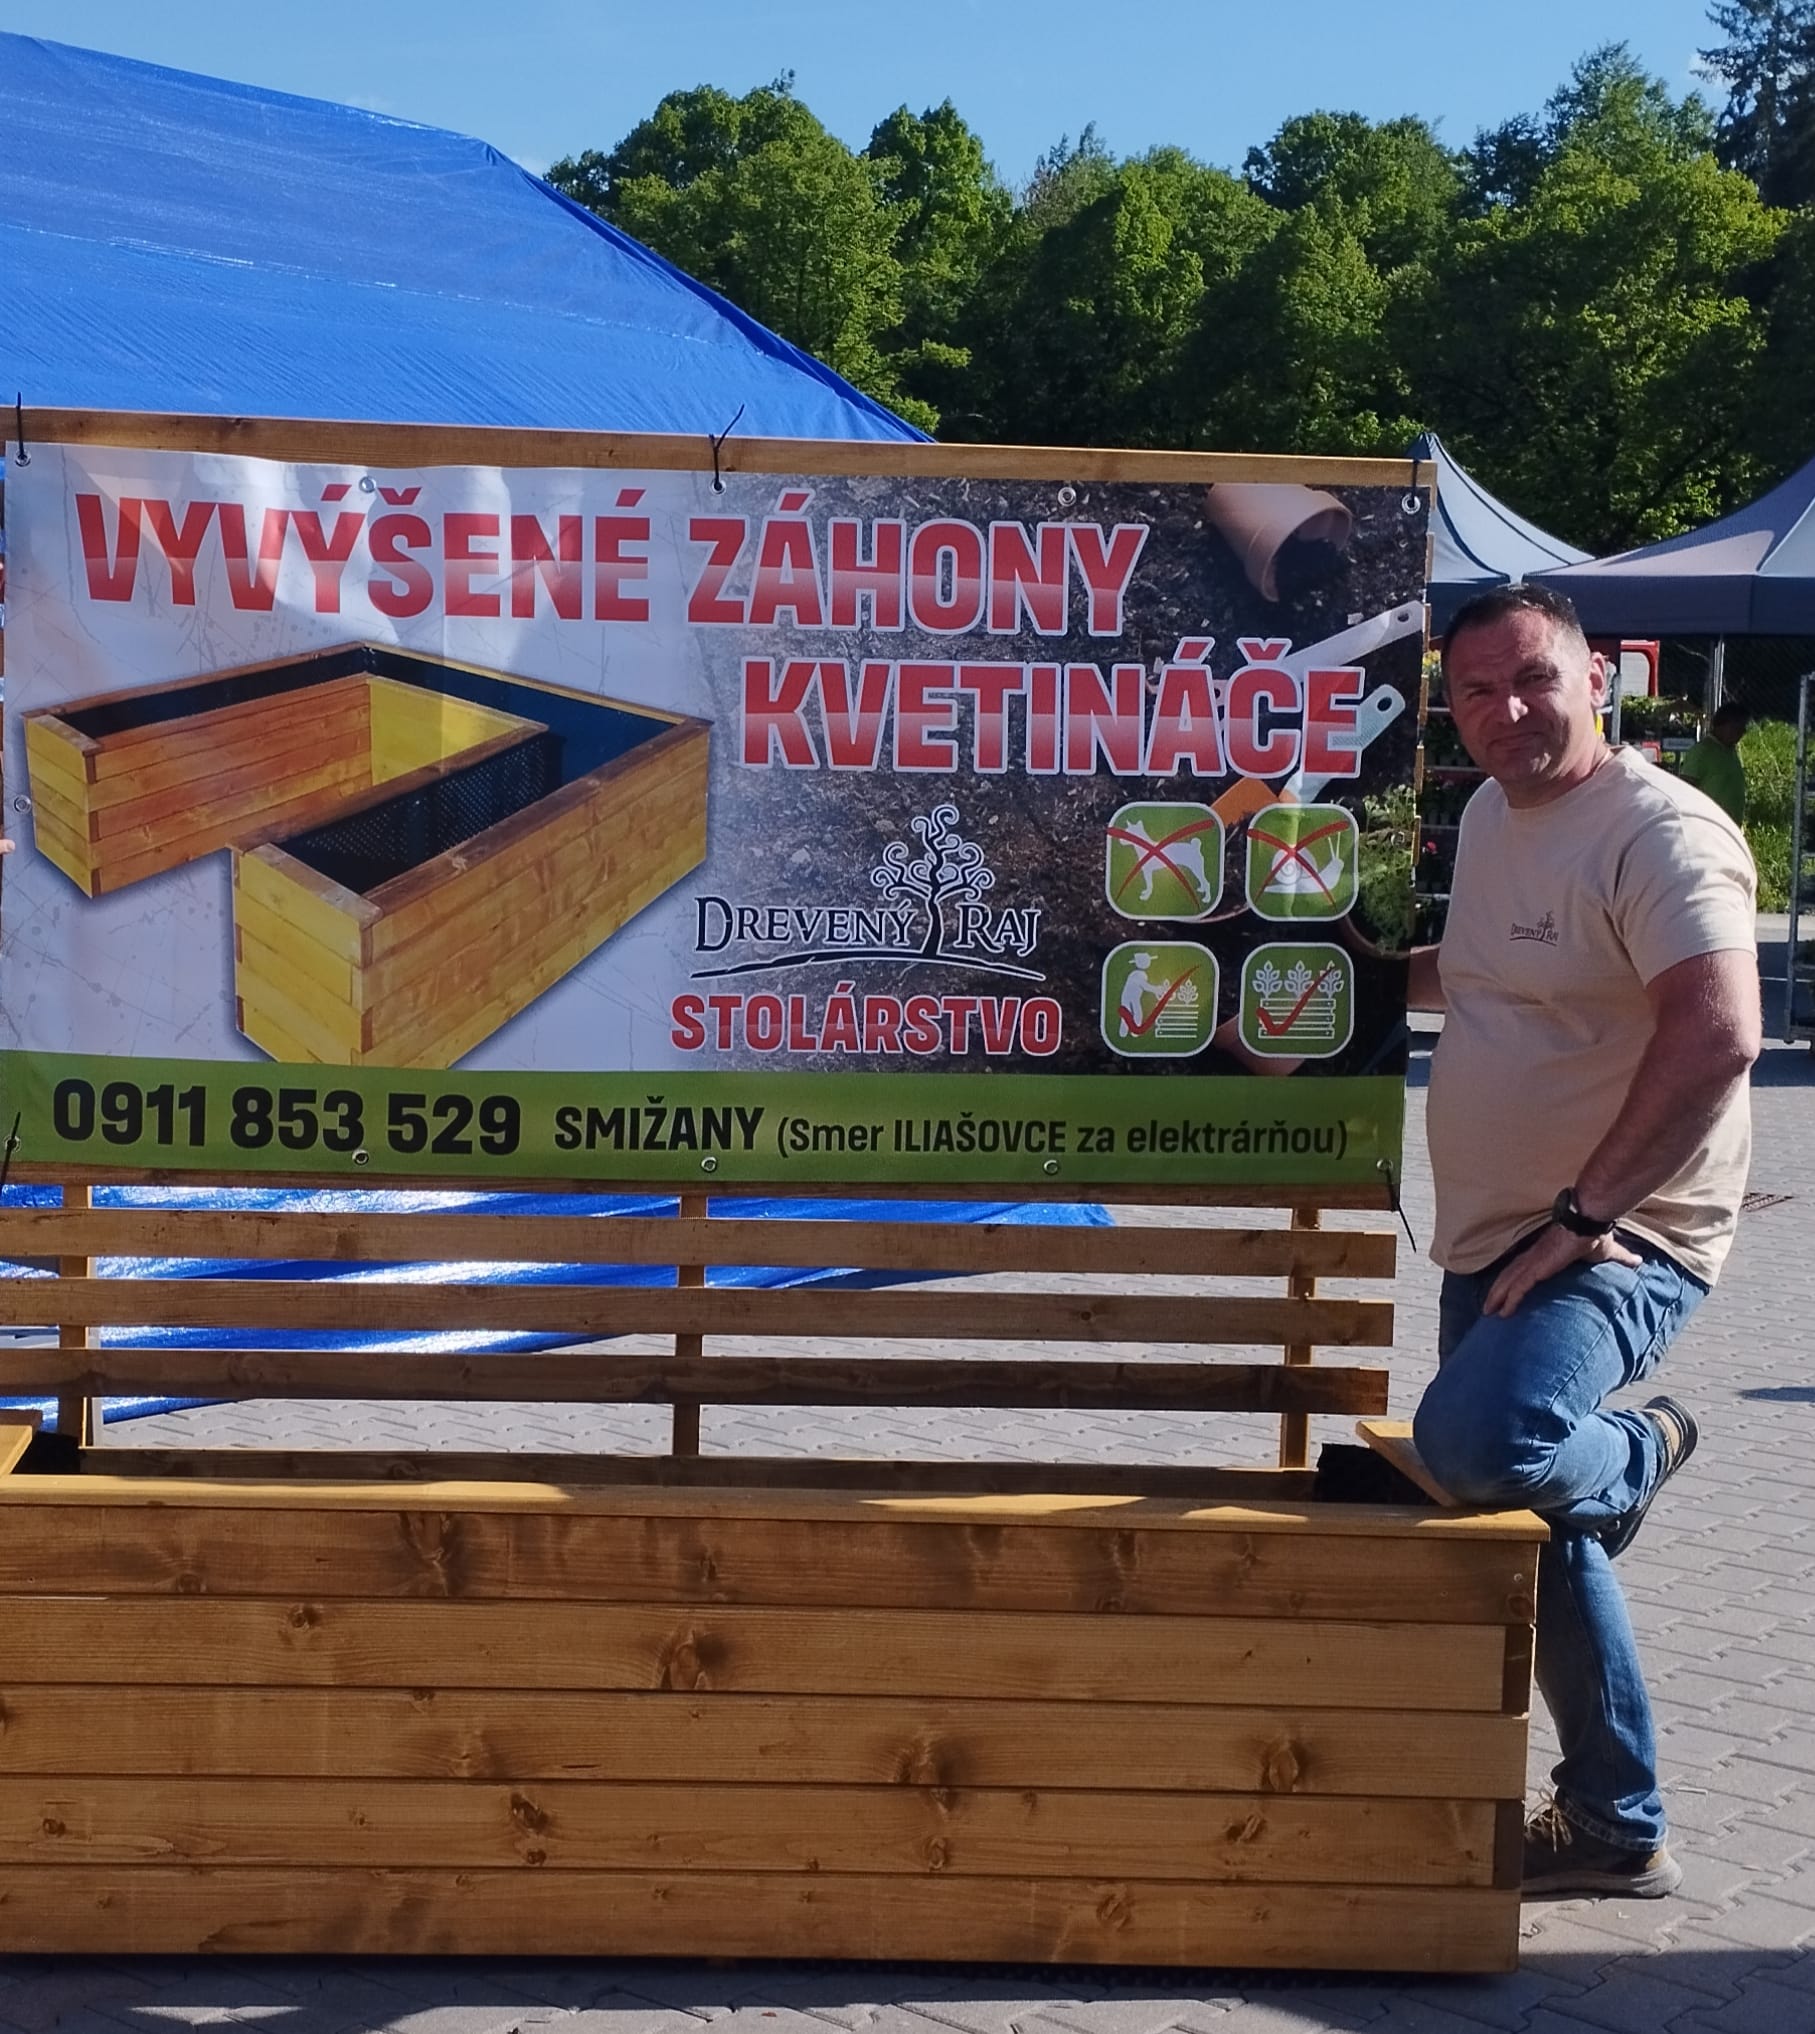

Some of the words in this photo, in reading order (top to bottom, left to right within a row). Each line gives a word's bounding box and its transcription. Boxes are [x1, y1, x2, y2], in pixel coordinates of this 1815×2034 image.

[76, 484, 650, 622] VYVÝŠENÉ
[687, 487, 1149, 636] ZÁHONY
[740, 637, 1365, 778] KVETINÁČE
[694, 897, 917, 952] DREVENÝ
[953, 903, 1041, 956] RAJ
[670, 981, 1062, 1056] STOLÁRSTVO
[53, 1078, 206, 1146] 0911
[231, 1087, 365, 1151] 853
[387, 1093, 521, 1155] 529
[555, 1095, 764, 1150] SMIŽANY
[776, 1117, 885, 1157] (Smer
[893, 1112, 1066, 1153] ILIAŠOVCE
[1077, 1126, 1115, 1153] za
[1126, 1118, 1348, 1160] elektrárňou)
